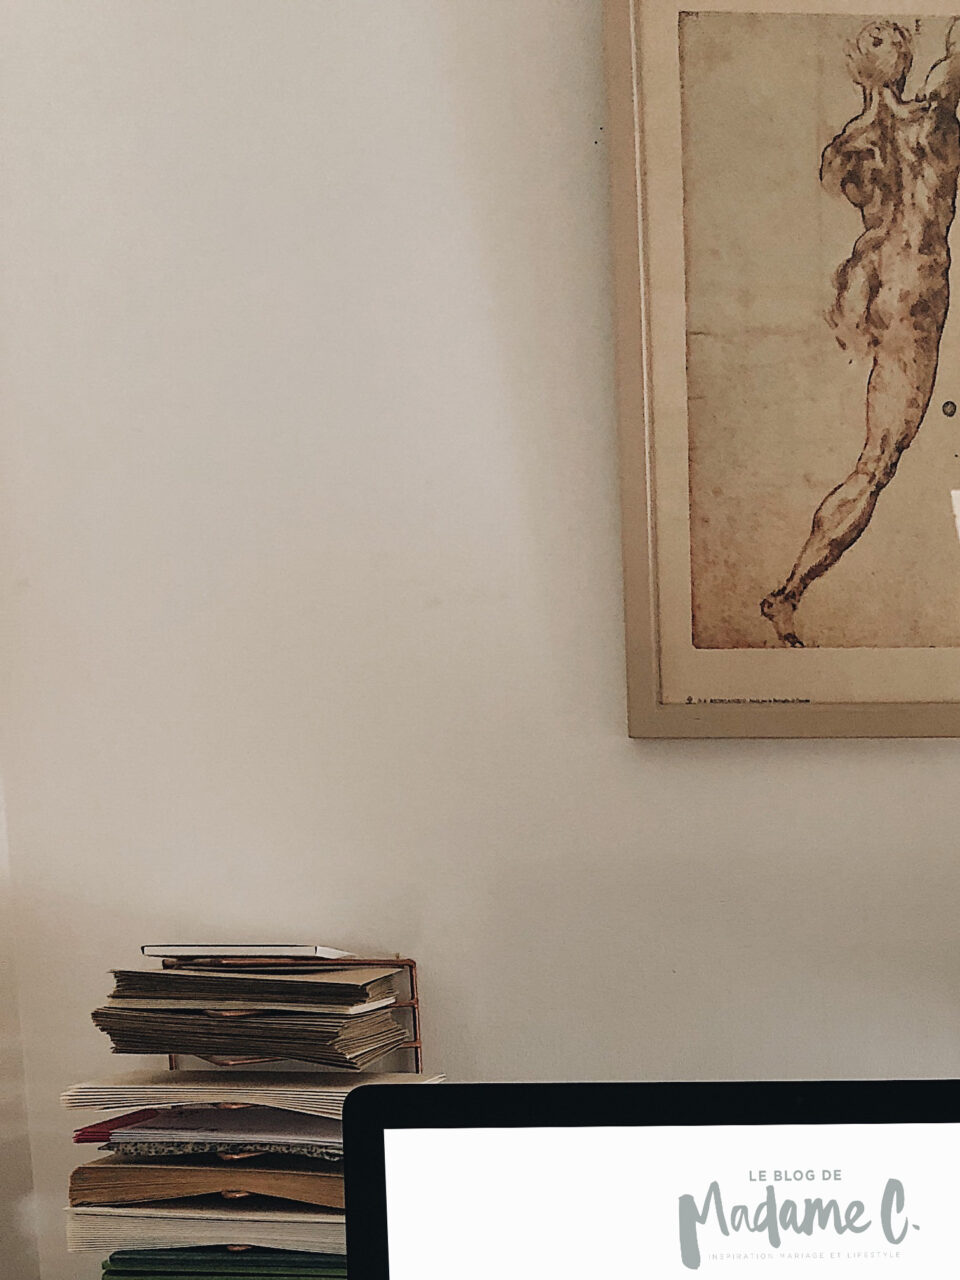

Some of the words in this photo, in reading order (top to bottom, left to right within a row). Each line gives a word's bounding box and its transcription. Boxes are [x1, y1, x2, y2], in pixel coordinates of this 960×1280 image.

[749, 1169, 767, 1182] LE
[773, 1169, 815, 1182] BLOG
[821, 1168, 842, 1181] DE
[678, 1180, 872, 1270] Madame
[880, 1177, 921, 1245] C.
[708, 1252, 774, 1261] INSPIRATION
[779, 1252, 825, 1260] MARIAGE
[829, 1251, 842, 1259] ET
[847, 1250, 901, 1259] LIFESTYLE
